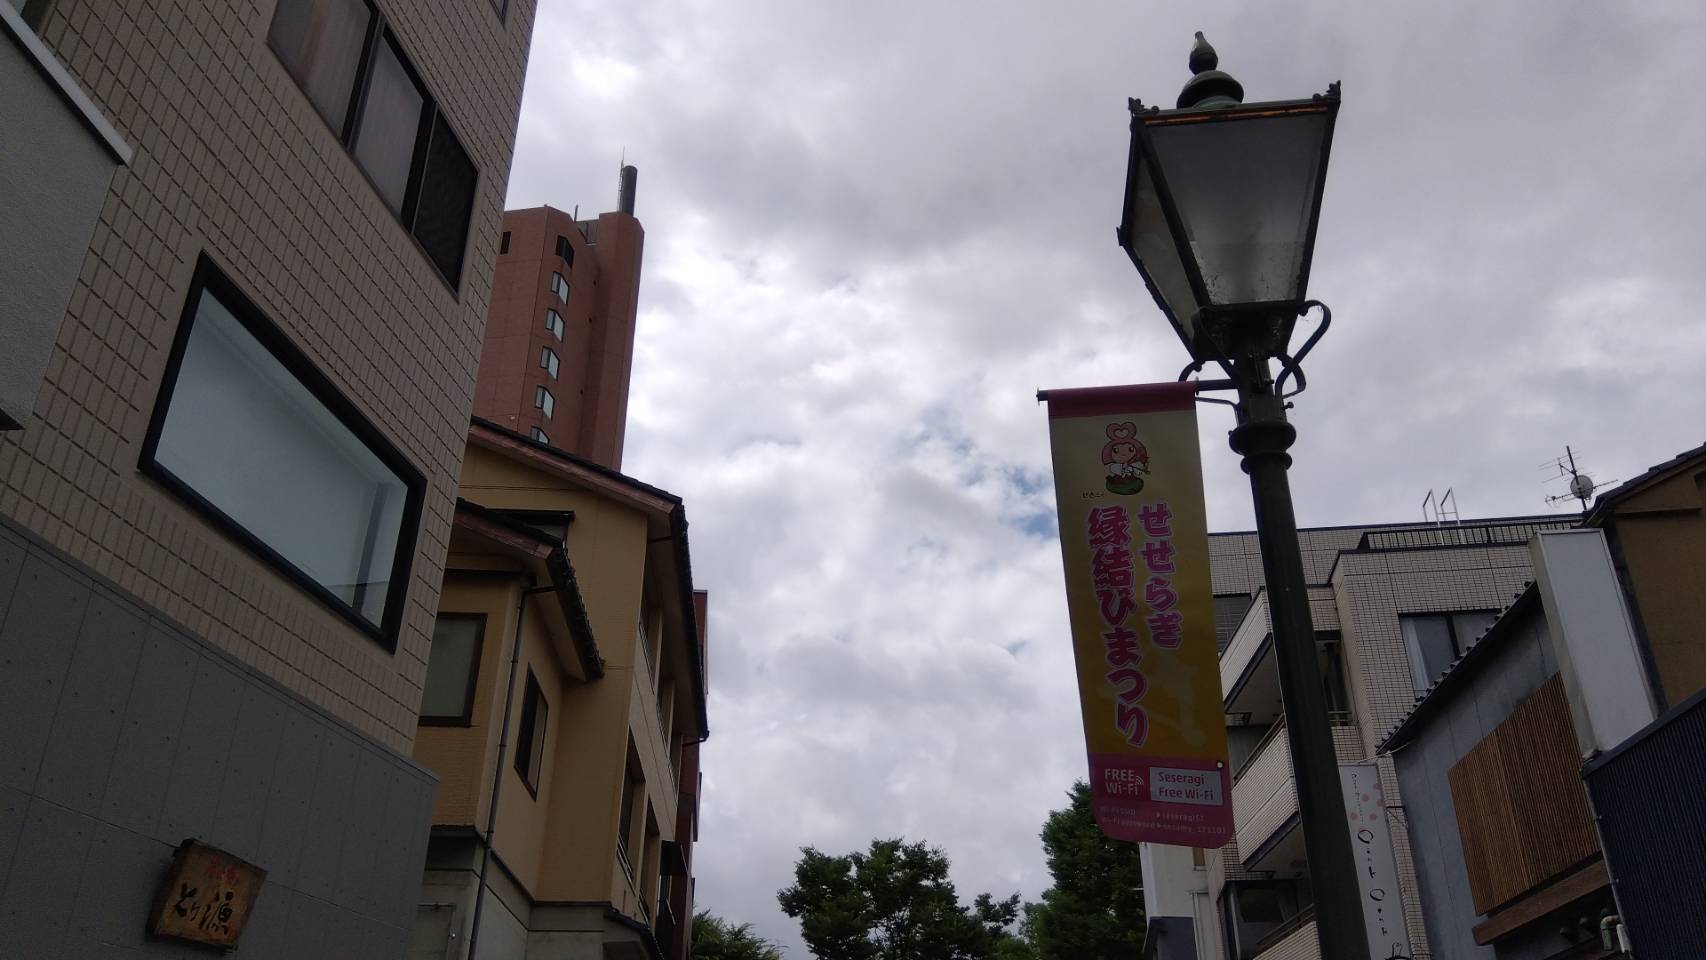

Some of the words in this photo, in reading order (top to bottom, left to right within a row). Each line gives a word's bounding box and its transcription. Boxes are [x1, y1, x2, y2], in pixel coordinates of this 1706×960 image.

[1138, 502, 1183, 650] せせらぎ
[1087, 506, 1149, 748] 縁結びまつり
[1104, 768, 1136, 781] FREE
[1158, 772, 1205, 786] Seseragi
[1105, 782, 1138, 796] Wi-Fi
[1159, 787, 1183, 798] Free
[1185, 789, 1214, 801] Wi-Fi
